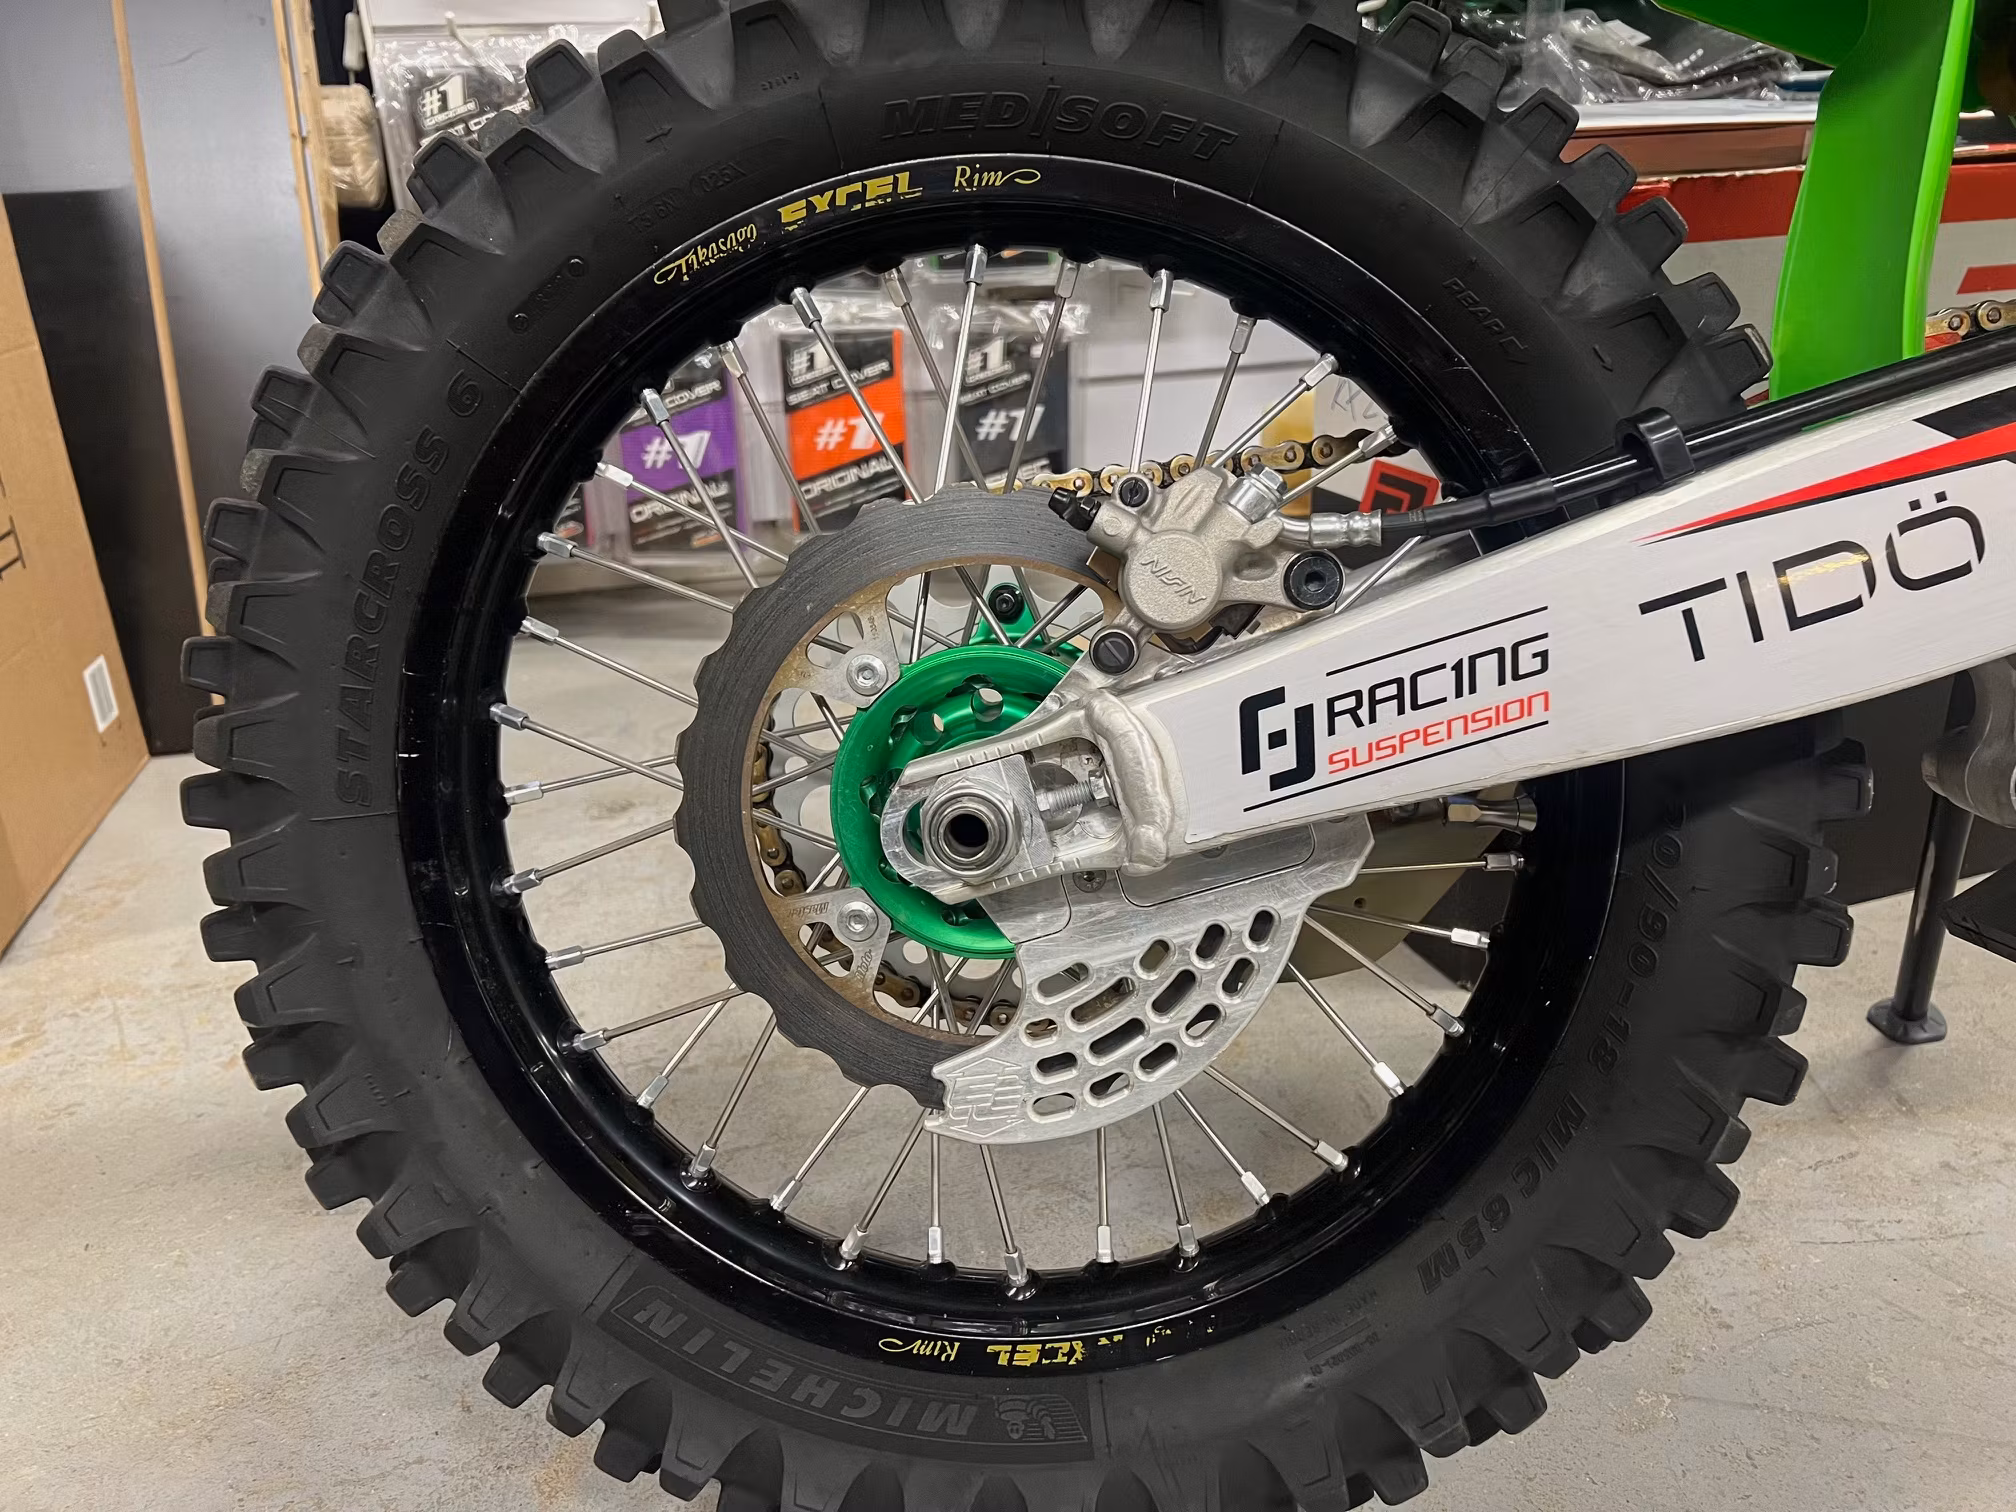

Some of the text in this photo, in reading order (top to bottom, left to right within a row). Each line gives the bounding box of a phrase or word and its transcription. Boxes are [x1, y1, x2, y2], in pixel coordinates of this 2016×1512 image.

[953, 163, 1042, 192] Rim
[1441, 276, 1506, 336] REAR
[664, 379, 722, 408] COVER
[334, 368, 484, 808] STARCROSS 6
[1638, 489, 1986, 662] TIDÖ
[1328, 690, 1550, 775] SUSPENSION
[1510, 1091, 1589, 1199] MIC
[631, 1300, 979, 1437] MICHELIN
